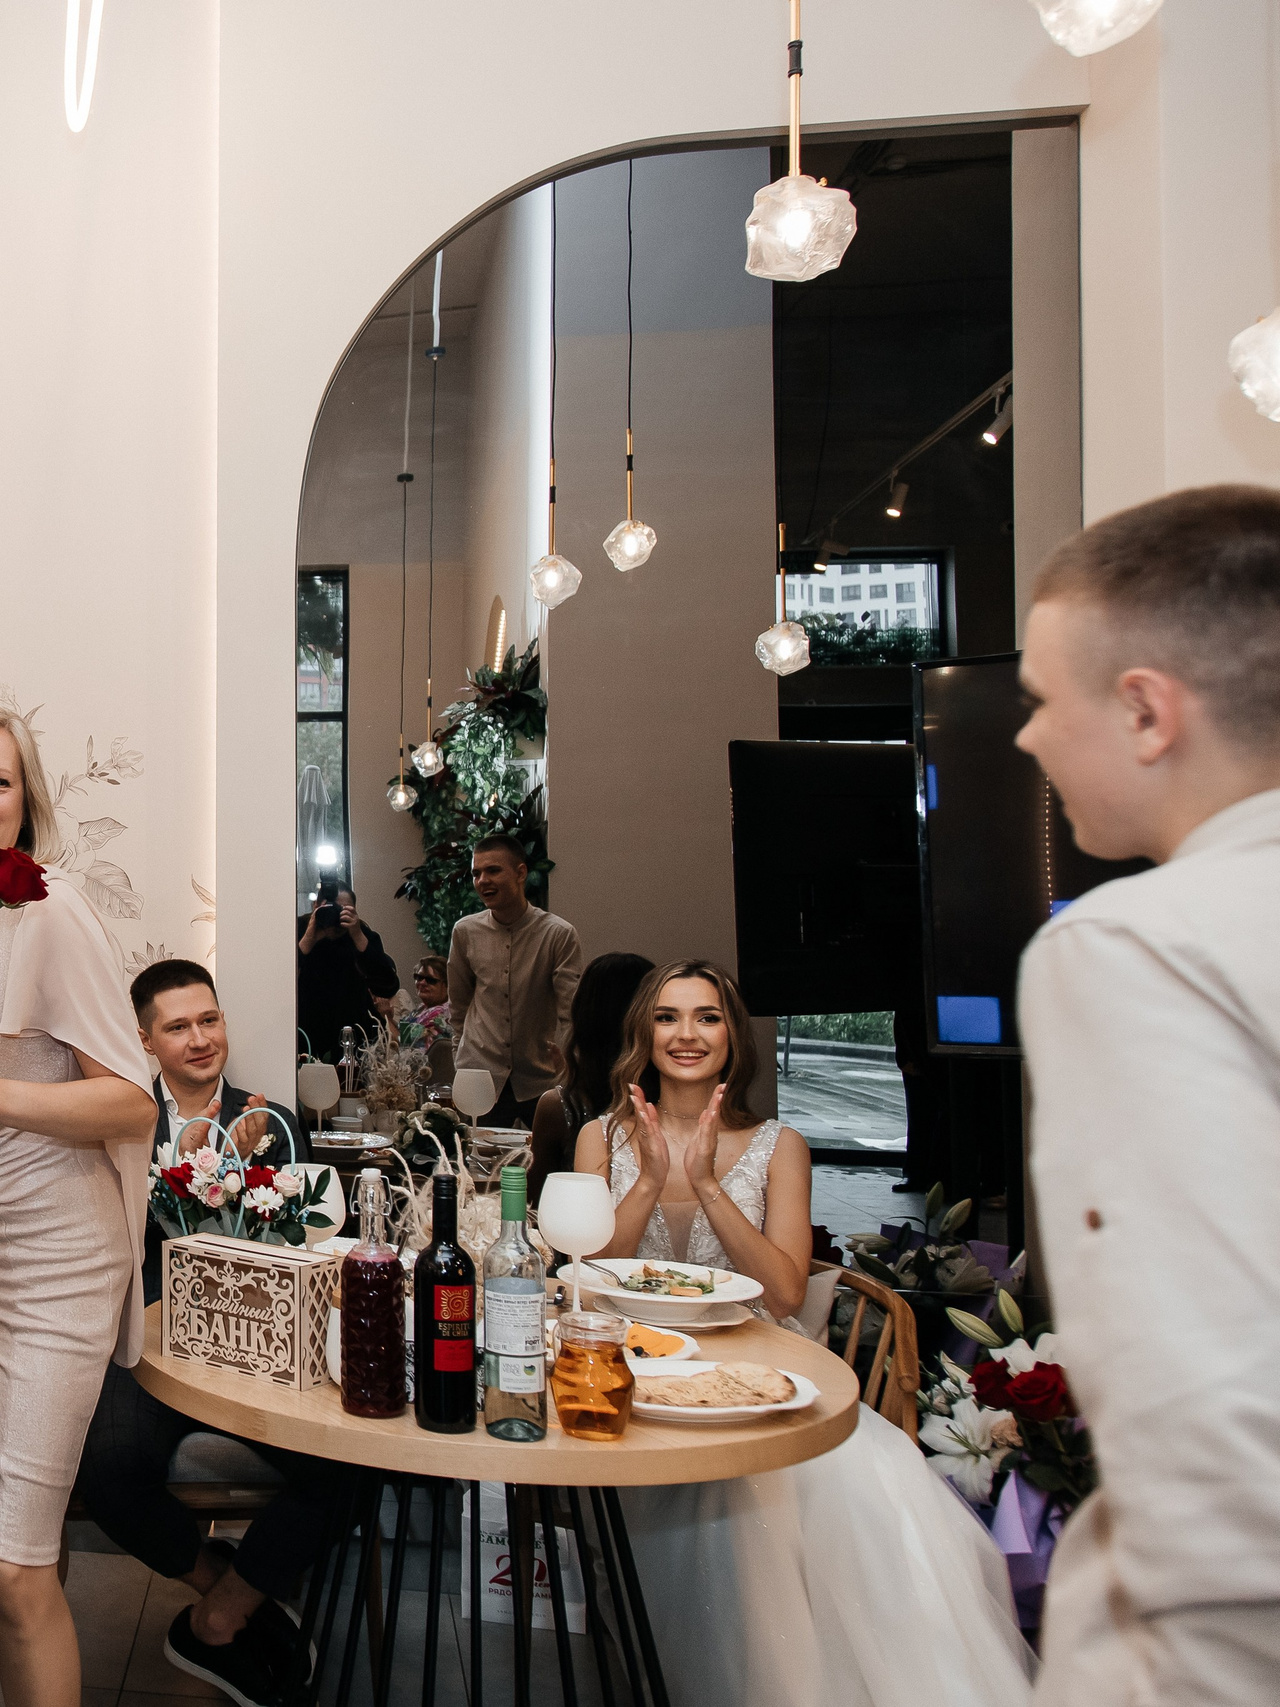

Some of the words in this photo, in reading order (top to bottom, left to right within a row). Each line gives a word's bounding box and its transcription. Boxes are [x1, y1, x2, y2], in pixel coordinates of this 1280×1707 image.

[186, 1278, 274, 1321] Семейный
[188, 1308, 275, 1356] БАНК
[488, 1587, 514, 1597] РЯДО
